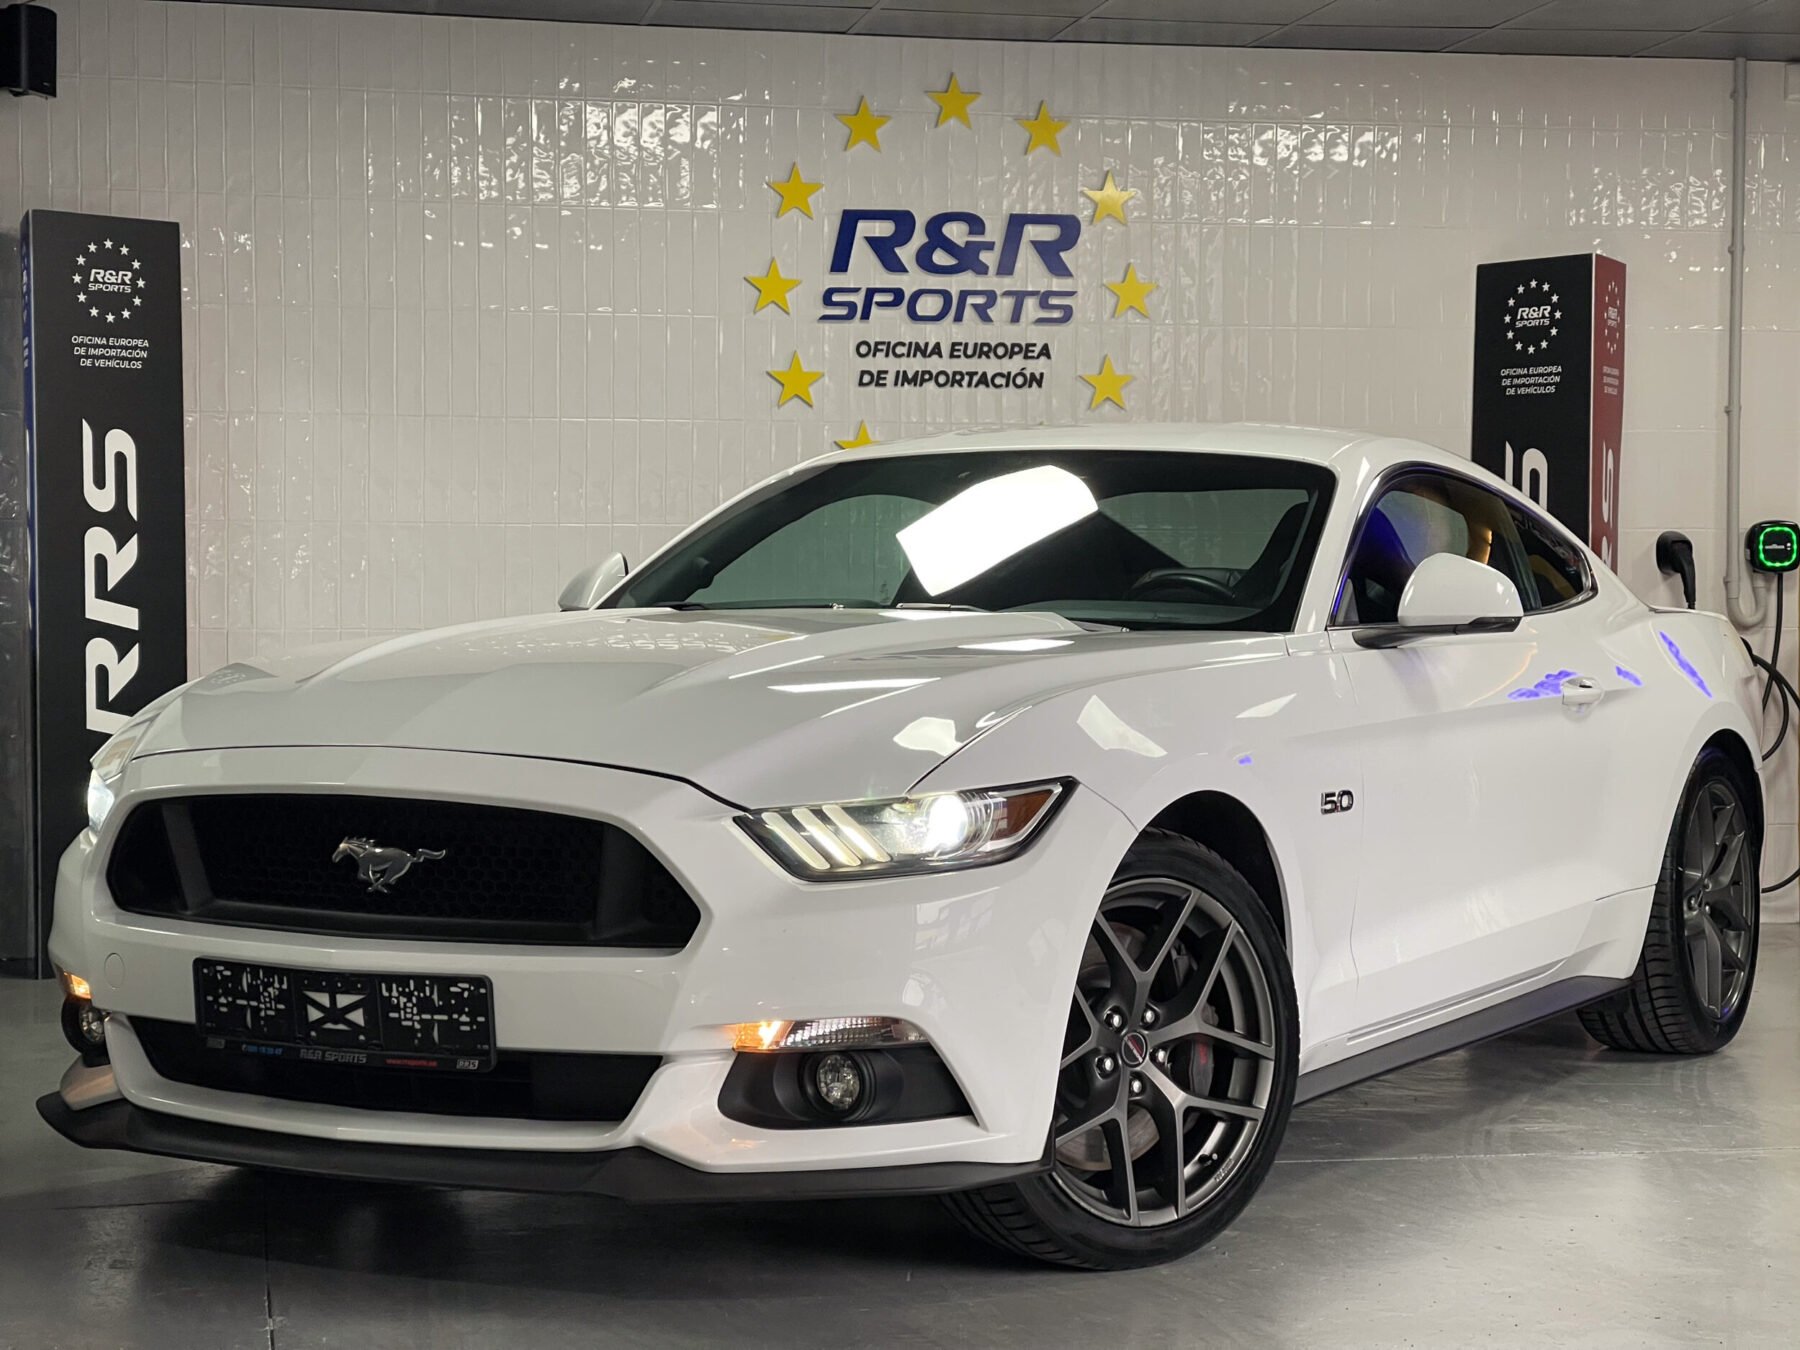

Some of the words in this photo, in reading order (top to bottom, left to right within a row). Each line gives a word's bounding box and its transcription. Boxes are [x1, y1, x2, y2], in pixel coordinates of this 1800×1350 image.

[829, 209, 1081, 278] R&R
[89, 268, 132, 285] R&R
[88, 282, 132, 293] SPORTS
[817, 286, 1078, 324] SPORTS
[1516, 305, 1551, 320] R&R
[1515, 317, 1550, 328] SPORTS
[71, 335, 107, 346] OFICINA
[109, 337, 149, 348] EUROPEA
[74, 347, 87, 356] DE
[88, 347, 148, 359] IMPORTACIÓN
[855, 339, 943, 359] OFICINA
[949, 341, 1051, 361] EUROPEA
[80, 358, 93, 367] DE
[95, 358, 142, 369] VEHÍCULOS
[1500, 367, 1528, 376] OFICINA
[1529, 365, 1562, 375] EUROPEA
[857, 369, 888, 388] DE
[894, 367, 1044, 389] IMPORTACIÓN
[1502, 378, 1512, 386] DE
[1512, 375, 1560, 385] IMPORTACIÓN
[1506, 387, 1516, 395] DE
[1517, 385, 1556, 395] VEHÍCULOS
[324, 1049, 367, 1064] SPORTS
